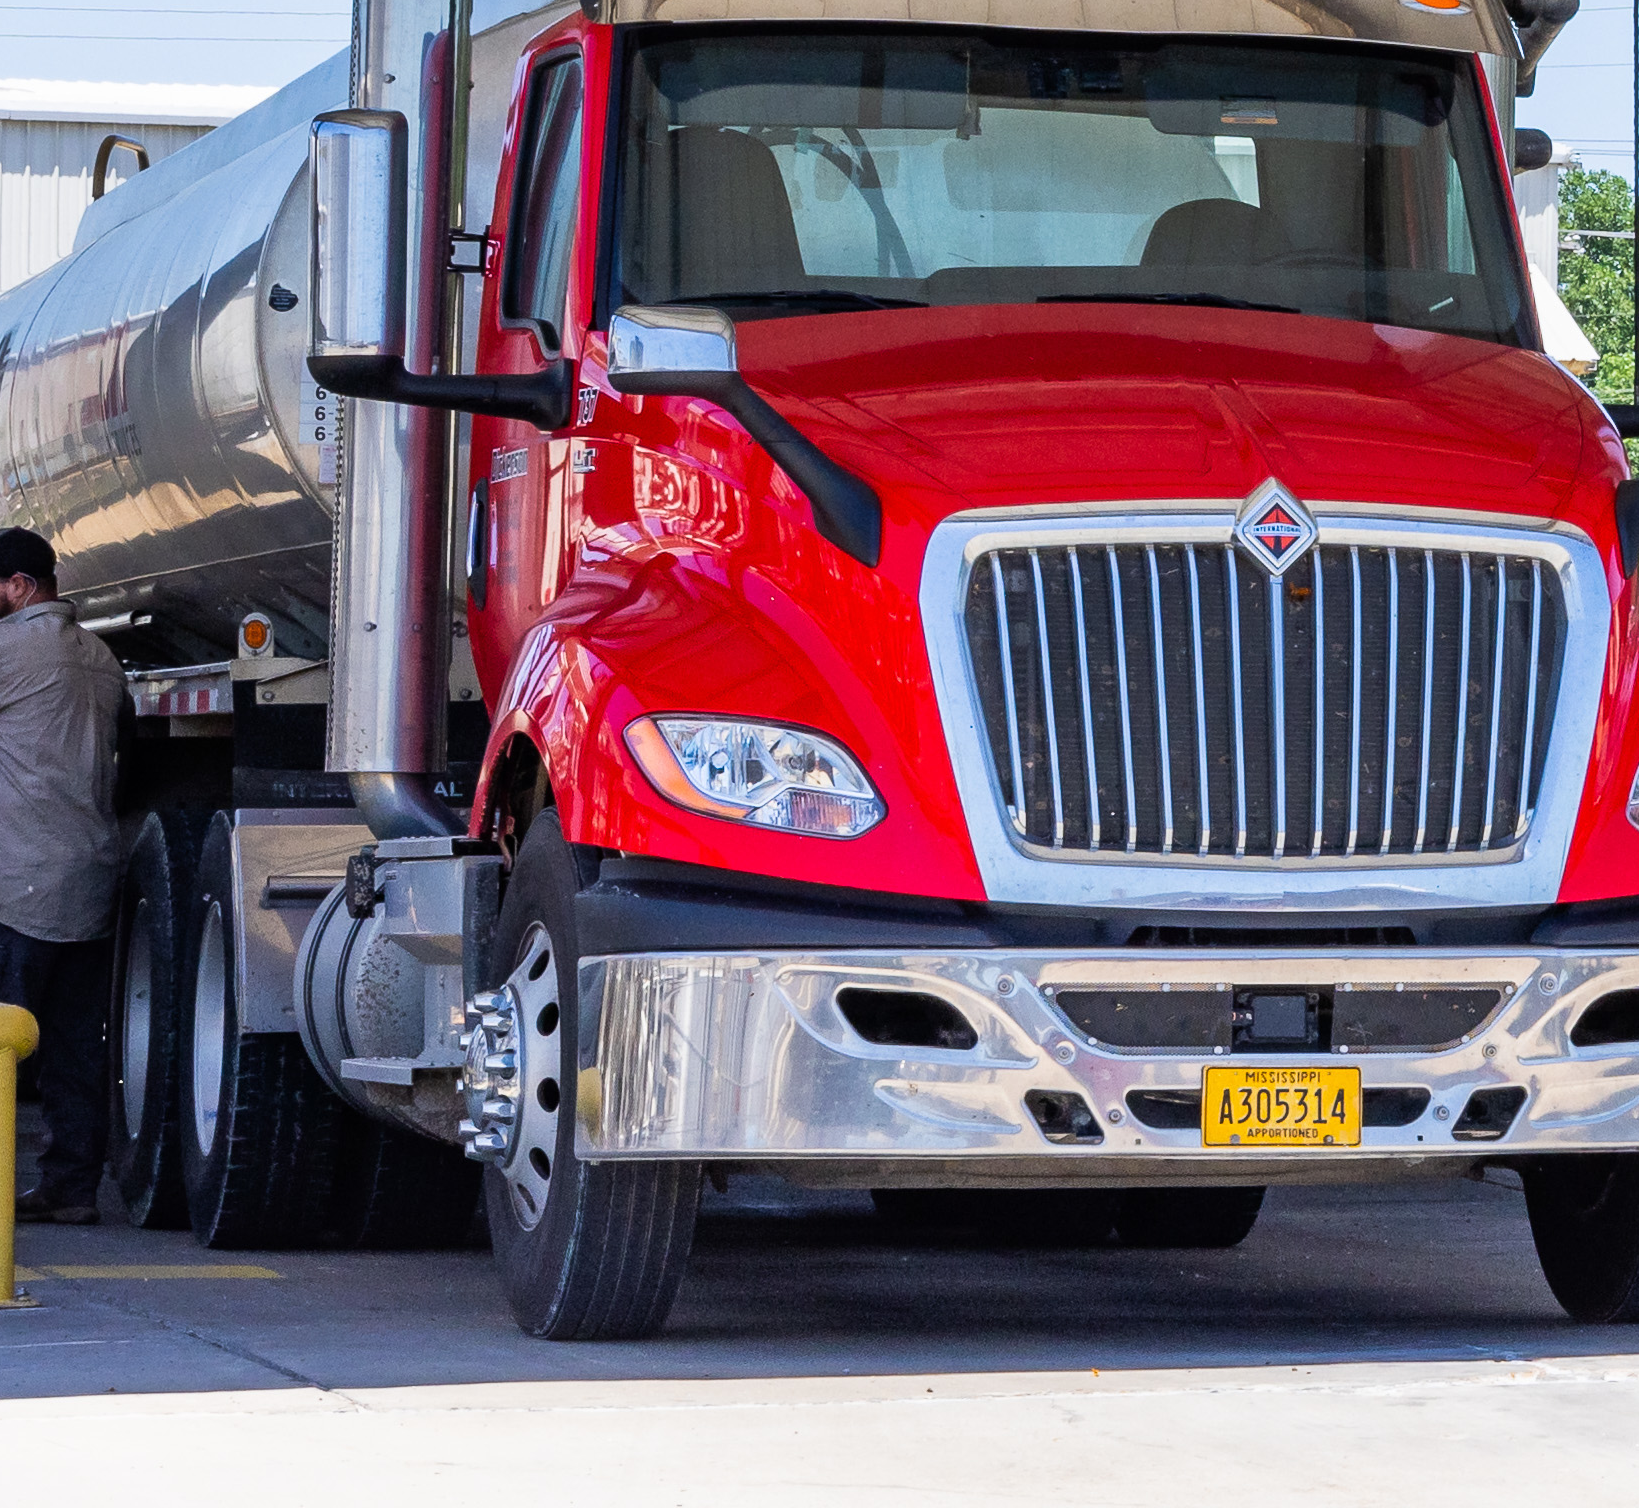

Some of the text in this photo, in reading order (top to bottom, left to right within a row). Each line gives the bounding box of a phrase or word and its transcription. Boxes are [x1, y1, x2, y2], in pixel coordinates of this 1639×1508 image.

[1253, 525, 1301, 533] INTERNATIONAL
[1245, 1071, 1321, 1084] MISSISSIPPI
[1219, 1088, 1346, 1125] A305314
[1247, 1127, 1319, 1139] APPORTIONED
